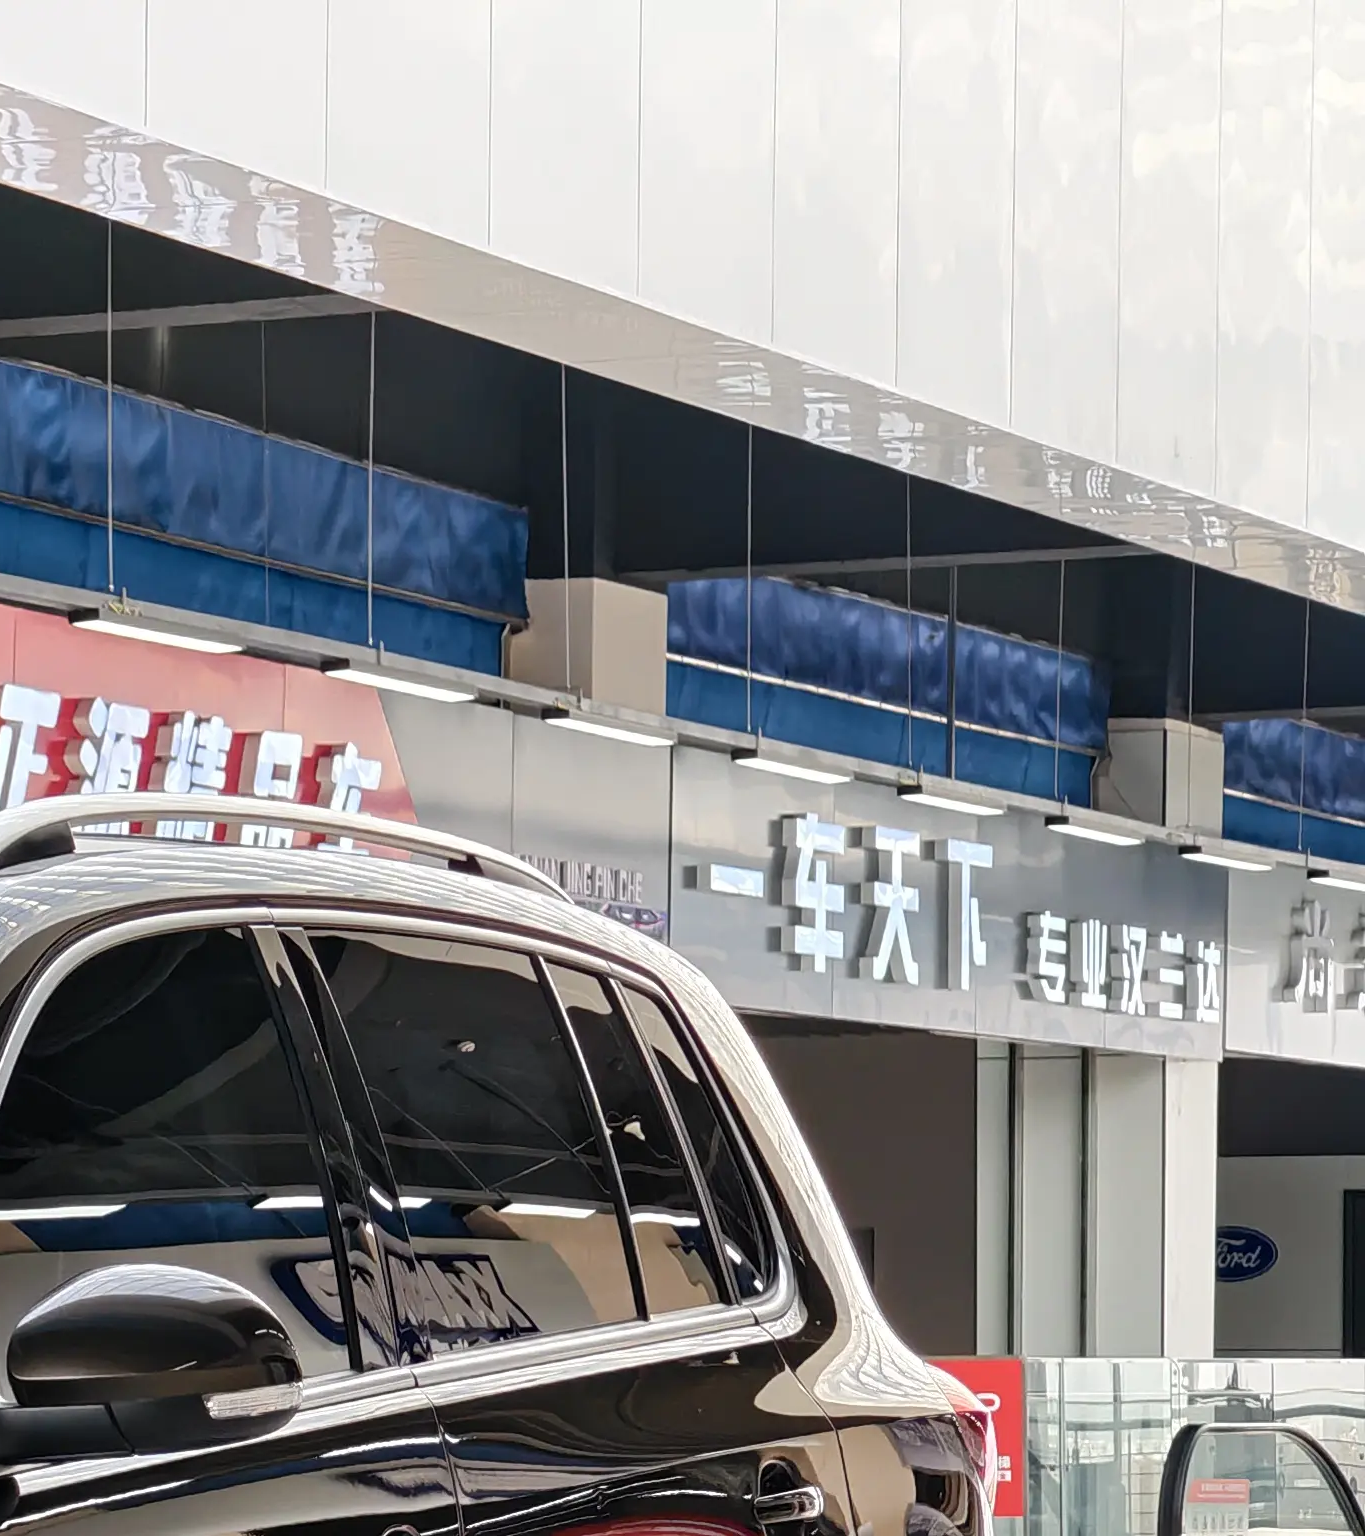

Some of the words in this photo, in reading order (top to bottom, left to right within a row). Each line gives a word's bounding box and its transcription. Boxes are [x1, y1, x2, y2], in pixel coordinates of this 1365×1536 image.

[701, 811, 993, 991] 一车天下
[1029, 911, 1221, 1023] 专业汉兰达
